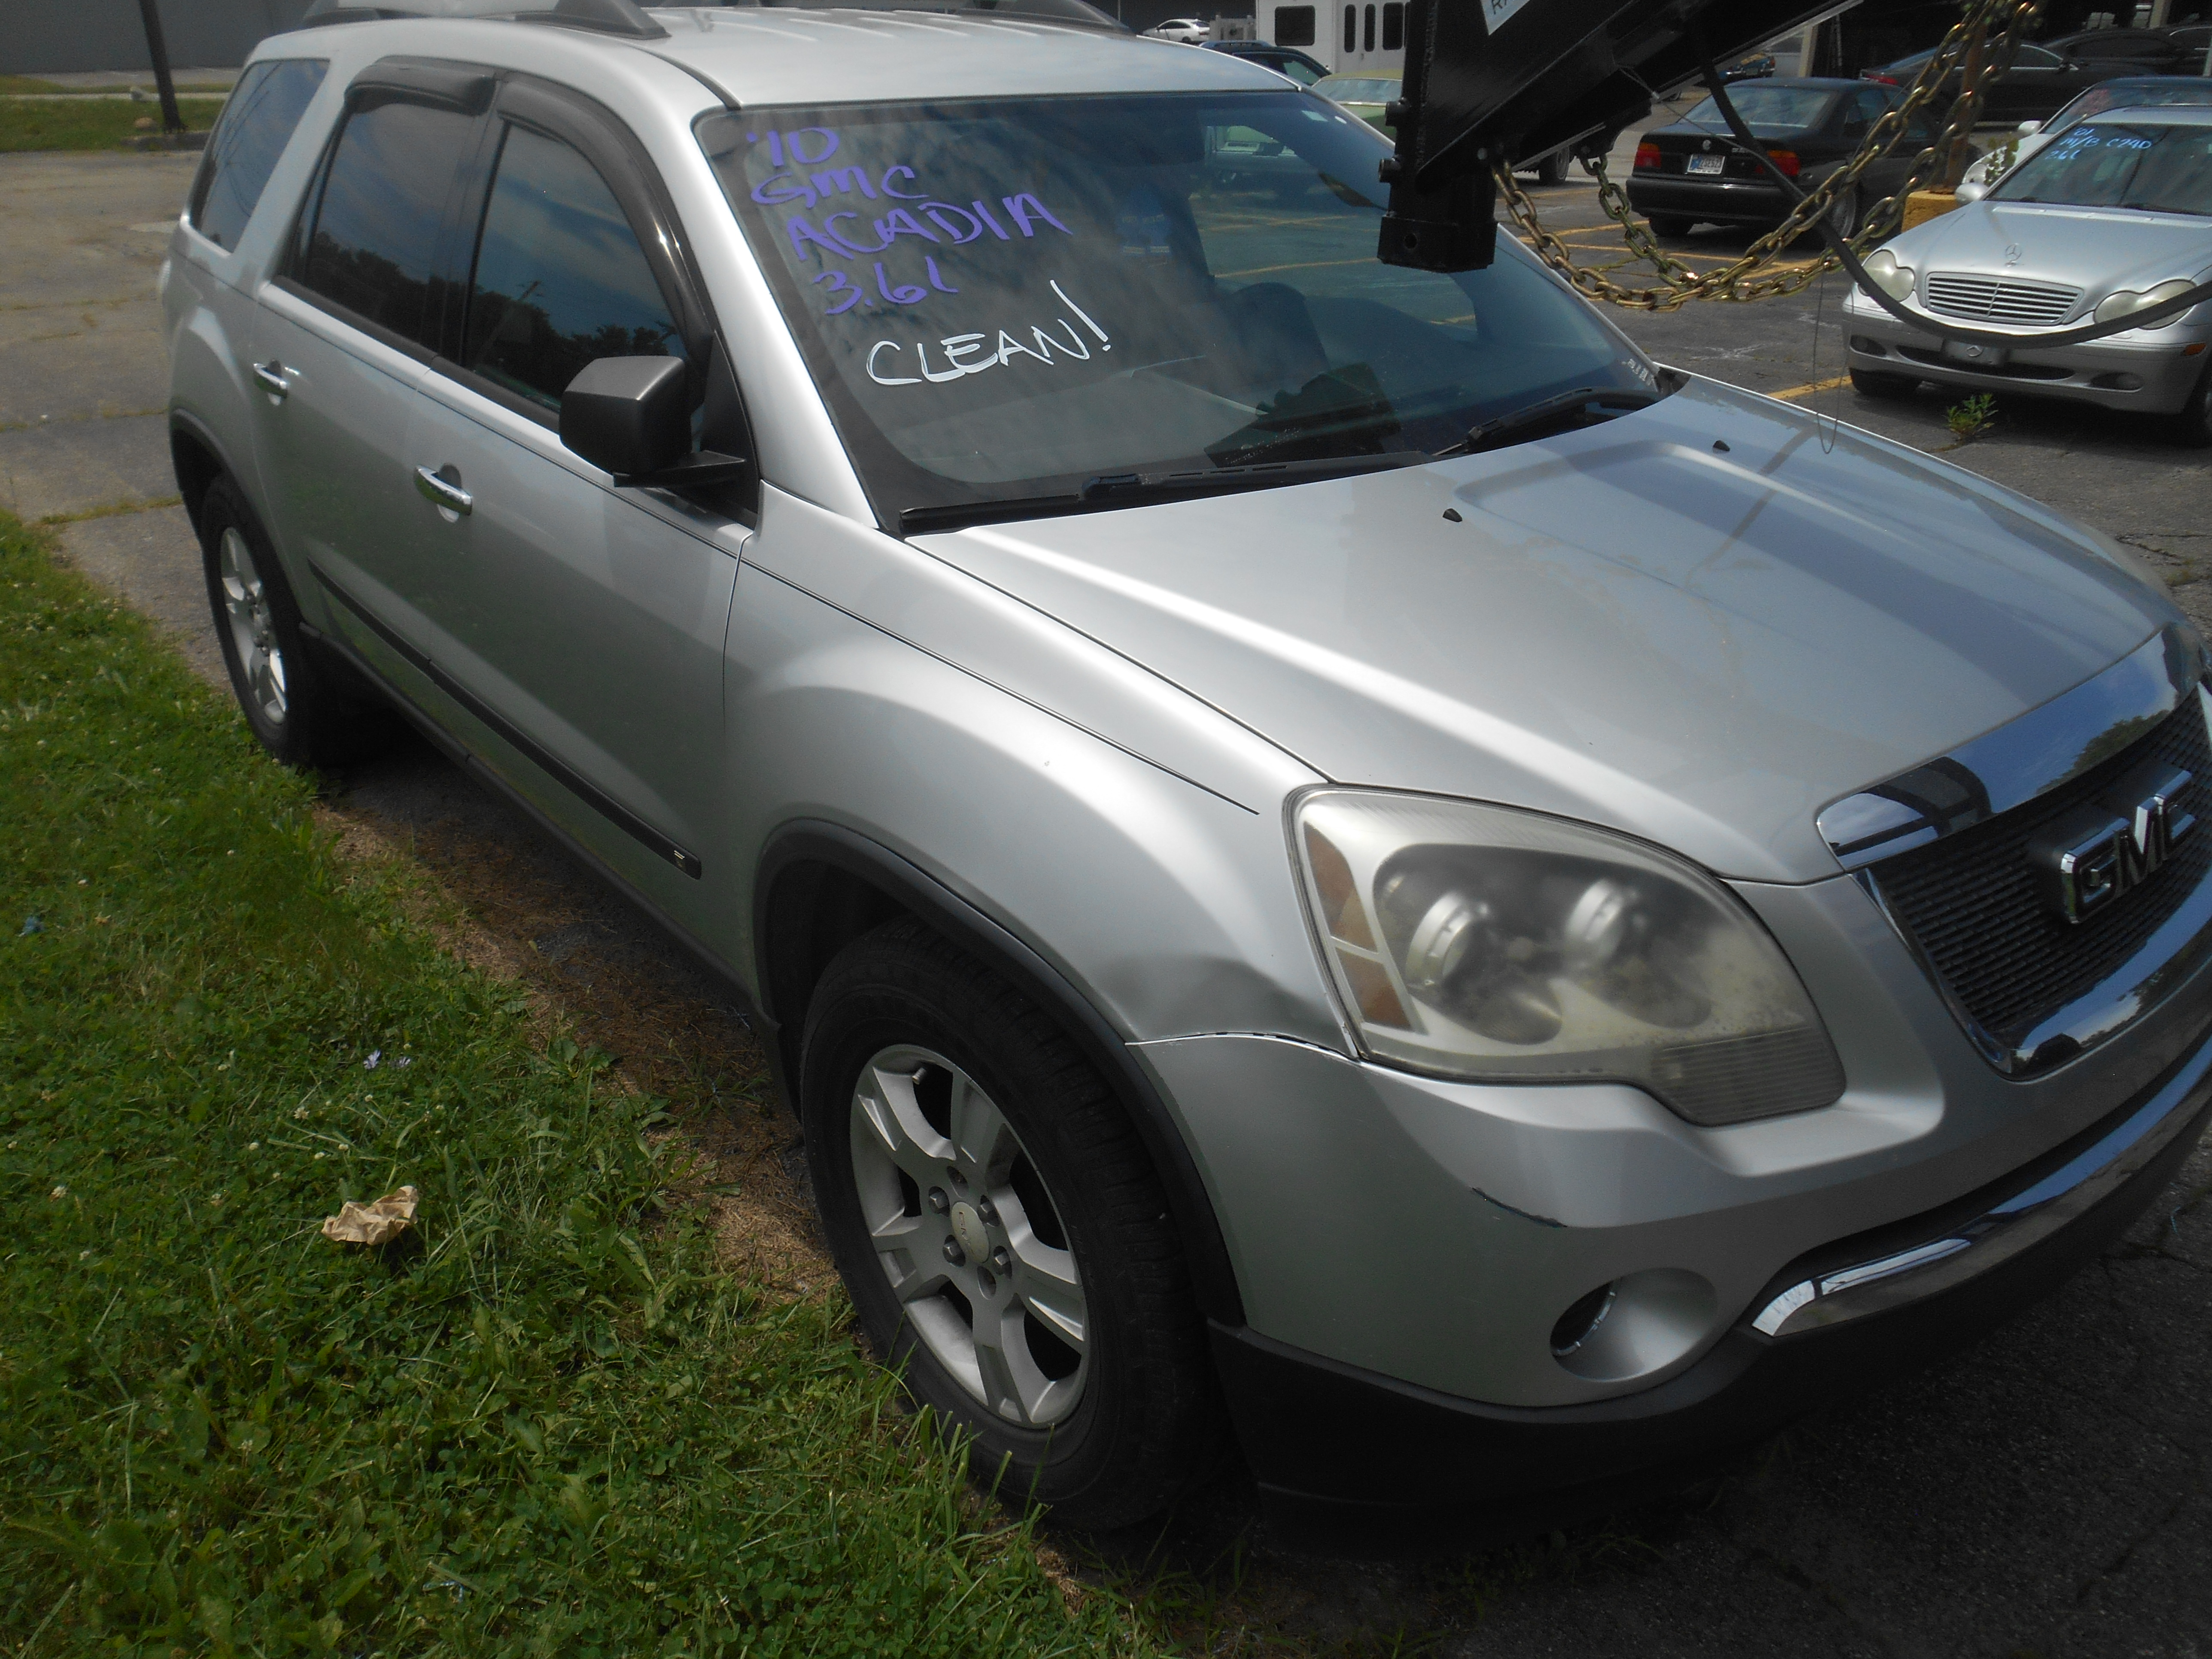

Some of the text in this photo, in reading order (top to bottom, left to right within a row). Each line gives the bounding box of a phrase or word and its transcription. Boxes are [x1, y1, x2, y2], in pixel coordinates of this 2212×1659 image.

[751, 165, 929, 209] GMC
[786, 192, 1073, 261] ACADIA
[866, 280, 1111, 385] CLEAN!
[2061, 770, 2197, 924] GMC
